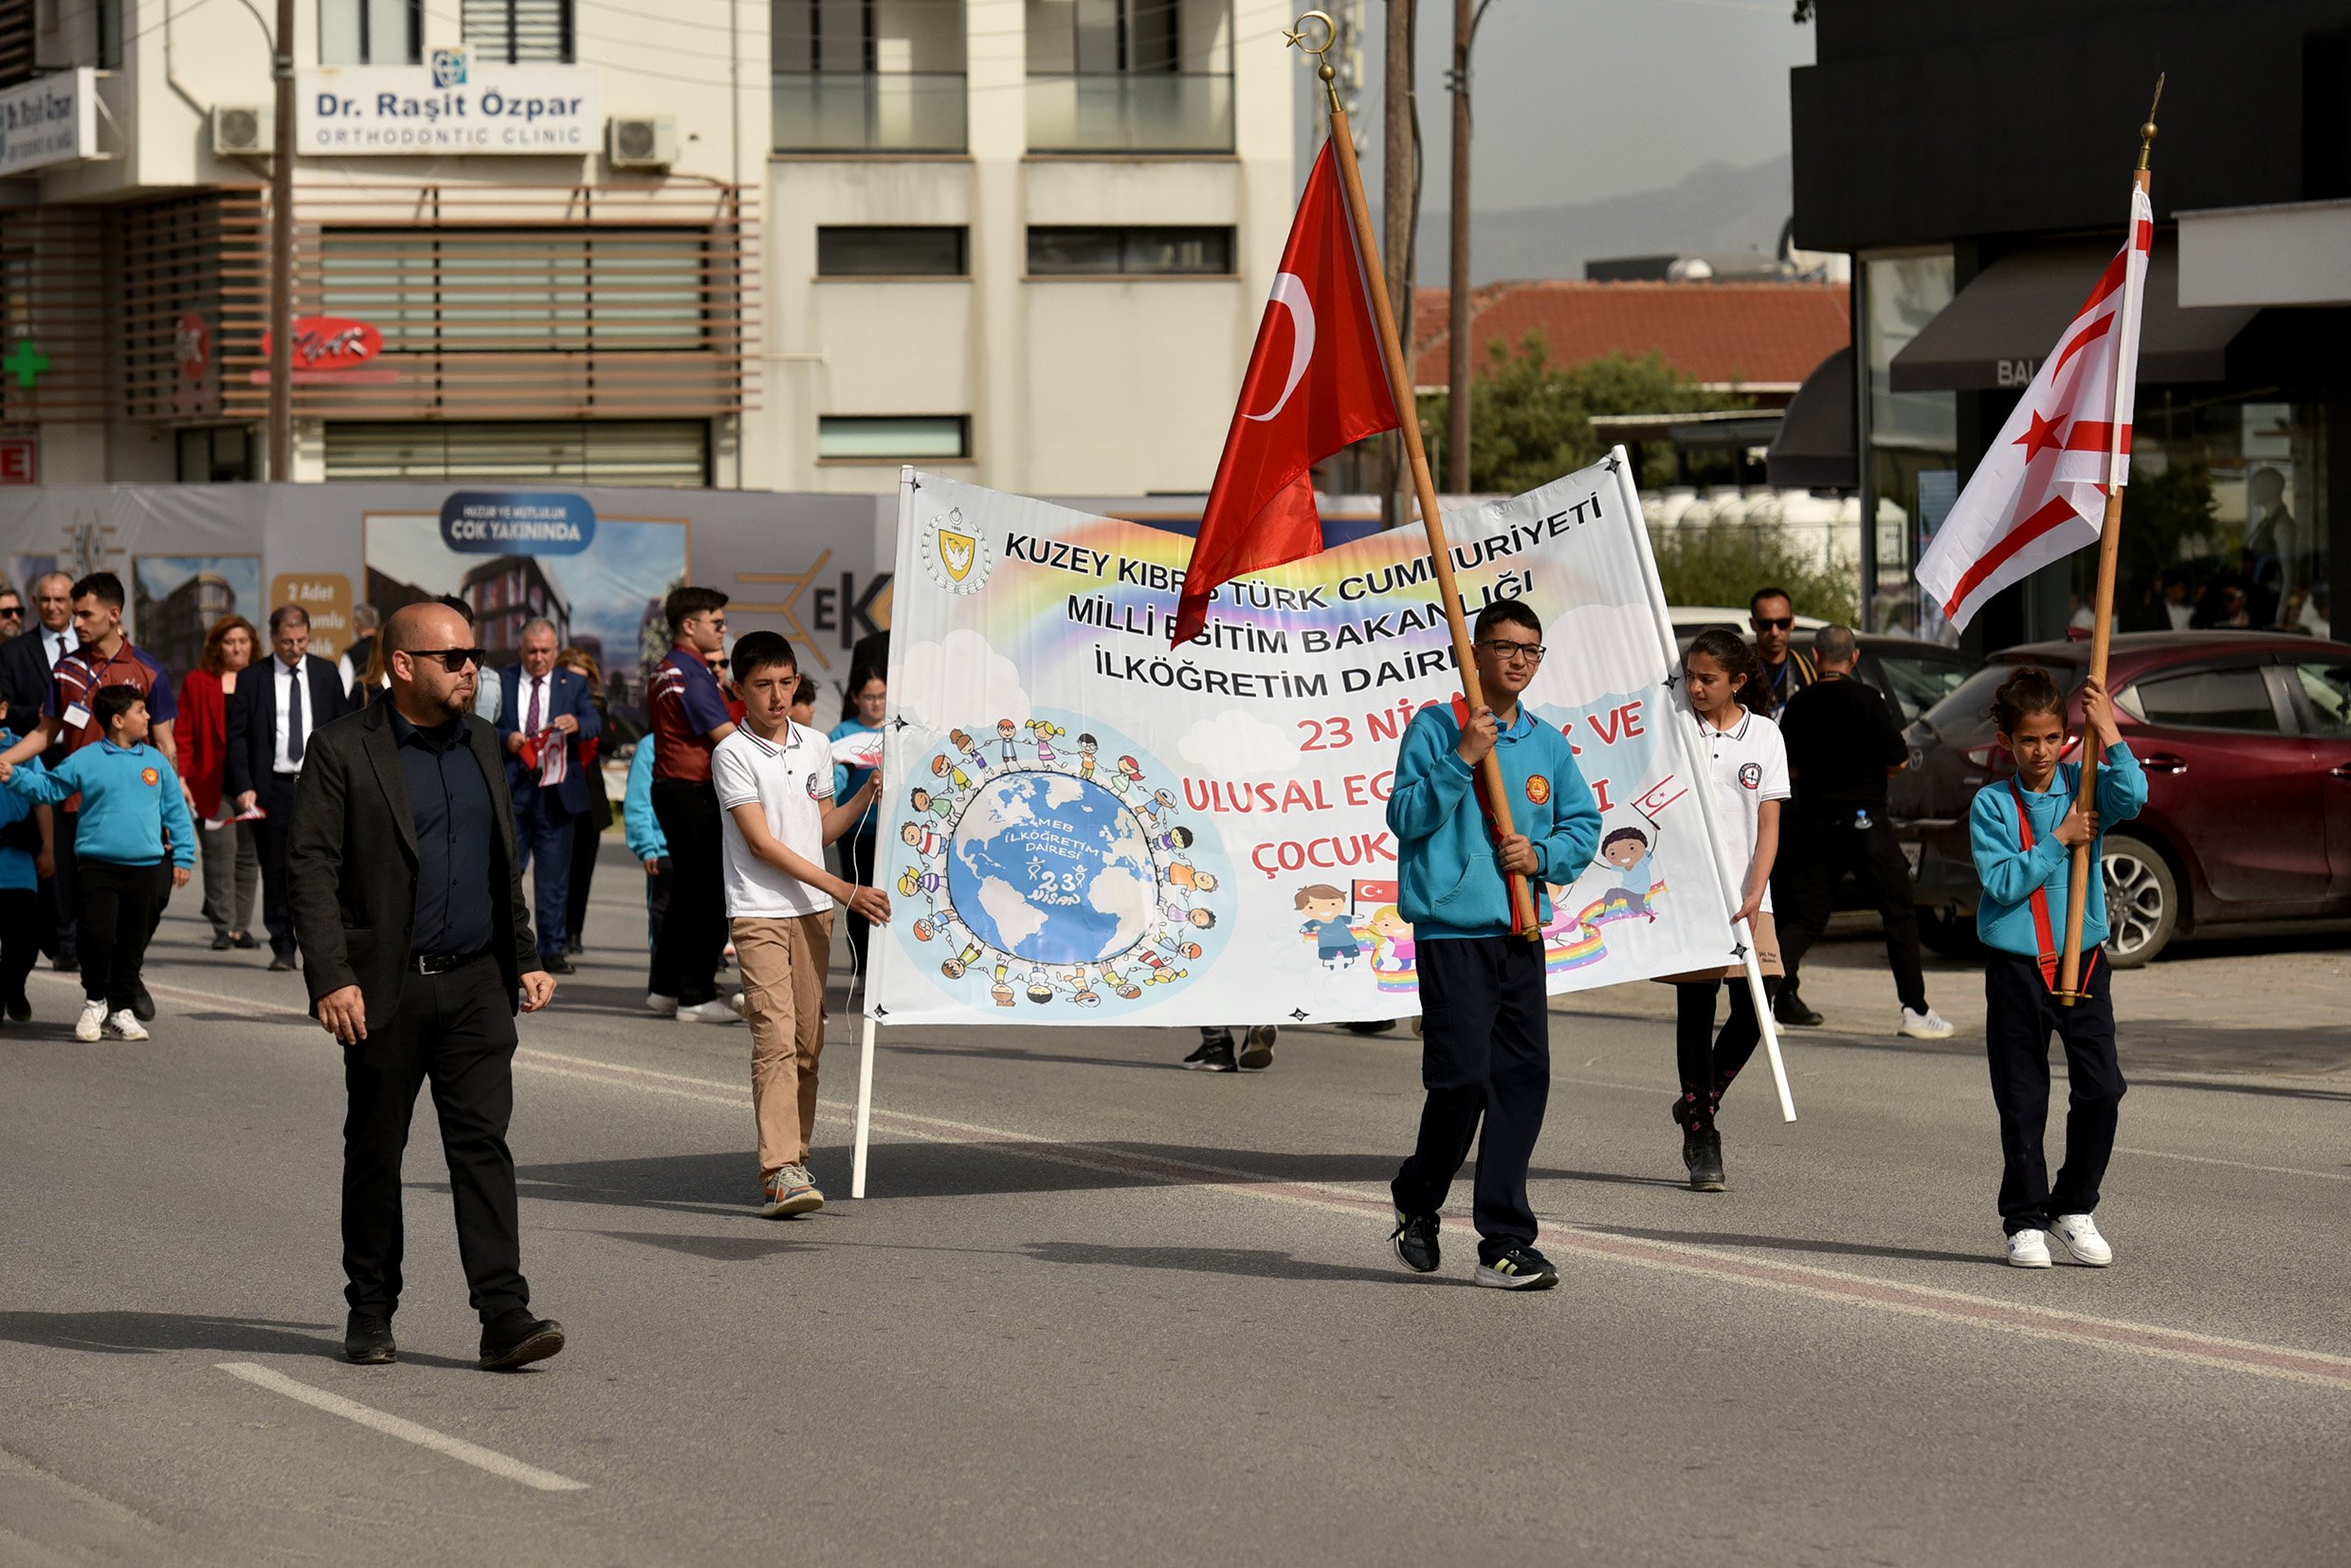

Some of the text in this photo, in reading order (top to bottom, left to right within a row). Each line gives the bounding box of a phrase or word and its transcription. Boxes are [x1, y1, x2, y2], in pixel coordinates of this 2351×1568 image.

[317, 85, 581, 122] Dr. Raşit Özpar
[317, 127, 581, 146] ORTHODONTIC CLINIC
[1005, 533, 1110, 576] KUZEY
[1119, 557, 1219, 601] KIBR
[1228, 580, 1328, 611] TÜRK
[1067, 594, 1155, 636] MİLLİ
[1095, 644, 1327, 699] İLKÖĞRETİM
[1297, 716, 1354, 752] 23
[1587, 701, 1645, 745] VE
[1182, 777, 1334, 813] ULUSAL
[1038, 818, 1074, 832] MEB
[1005, 830, 1100, 857] İLKÖĞRETİM
[1251, 831, 1397, 880] ÇOCUK
[1038, 870, 1076, 892] 23
